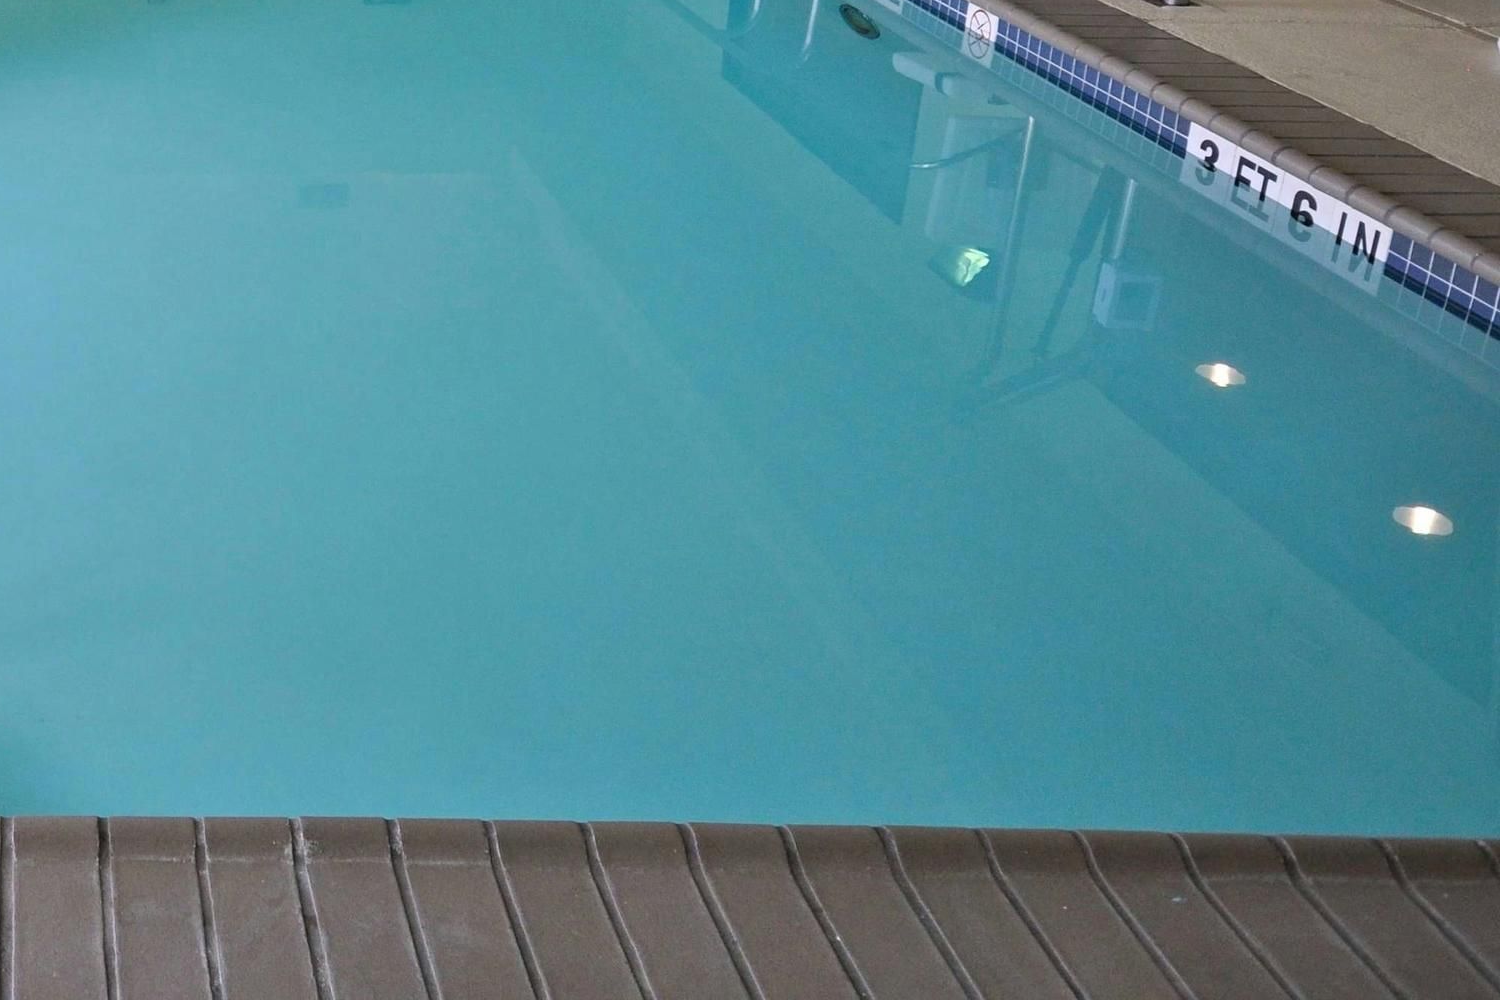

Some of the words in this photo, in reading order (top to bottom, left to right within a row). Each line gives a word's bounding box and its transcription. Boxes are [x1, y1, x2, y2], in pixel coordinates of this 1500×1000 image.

[1200, 139, 1220, 173] 3
[1234, 156, 1278, 202] FT
[1290, 190, 1317, 227] 6
[1335, 211, 1381, 265] IN
